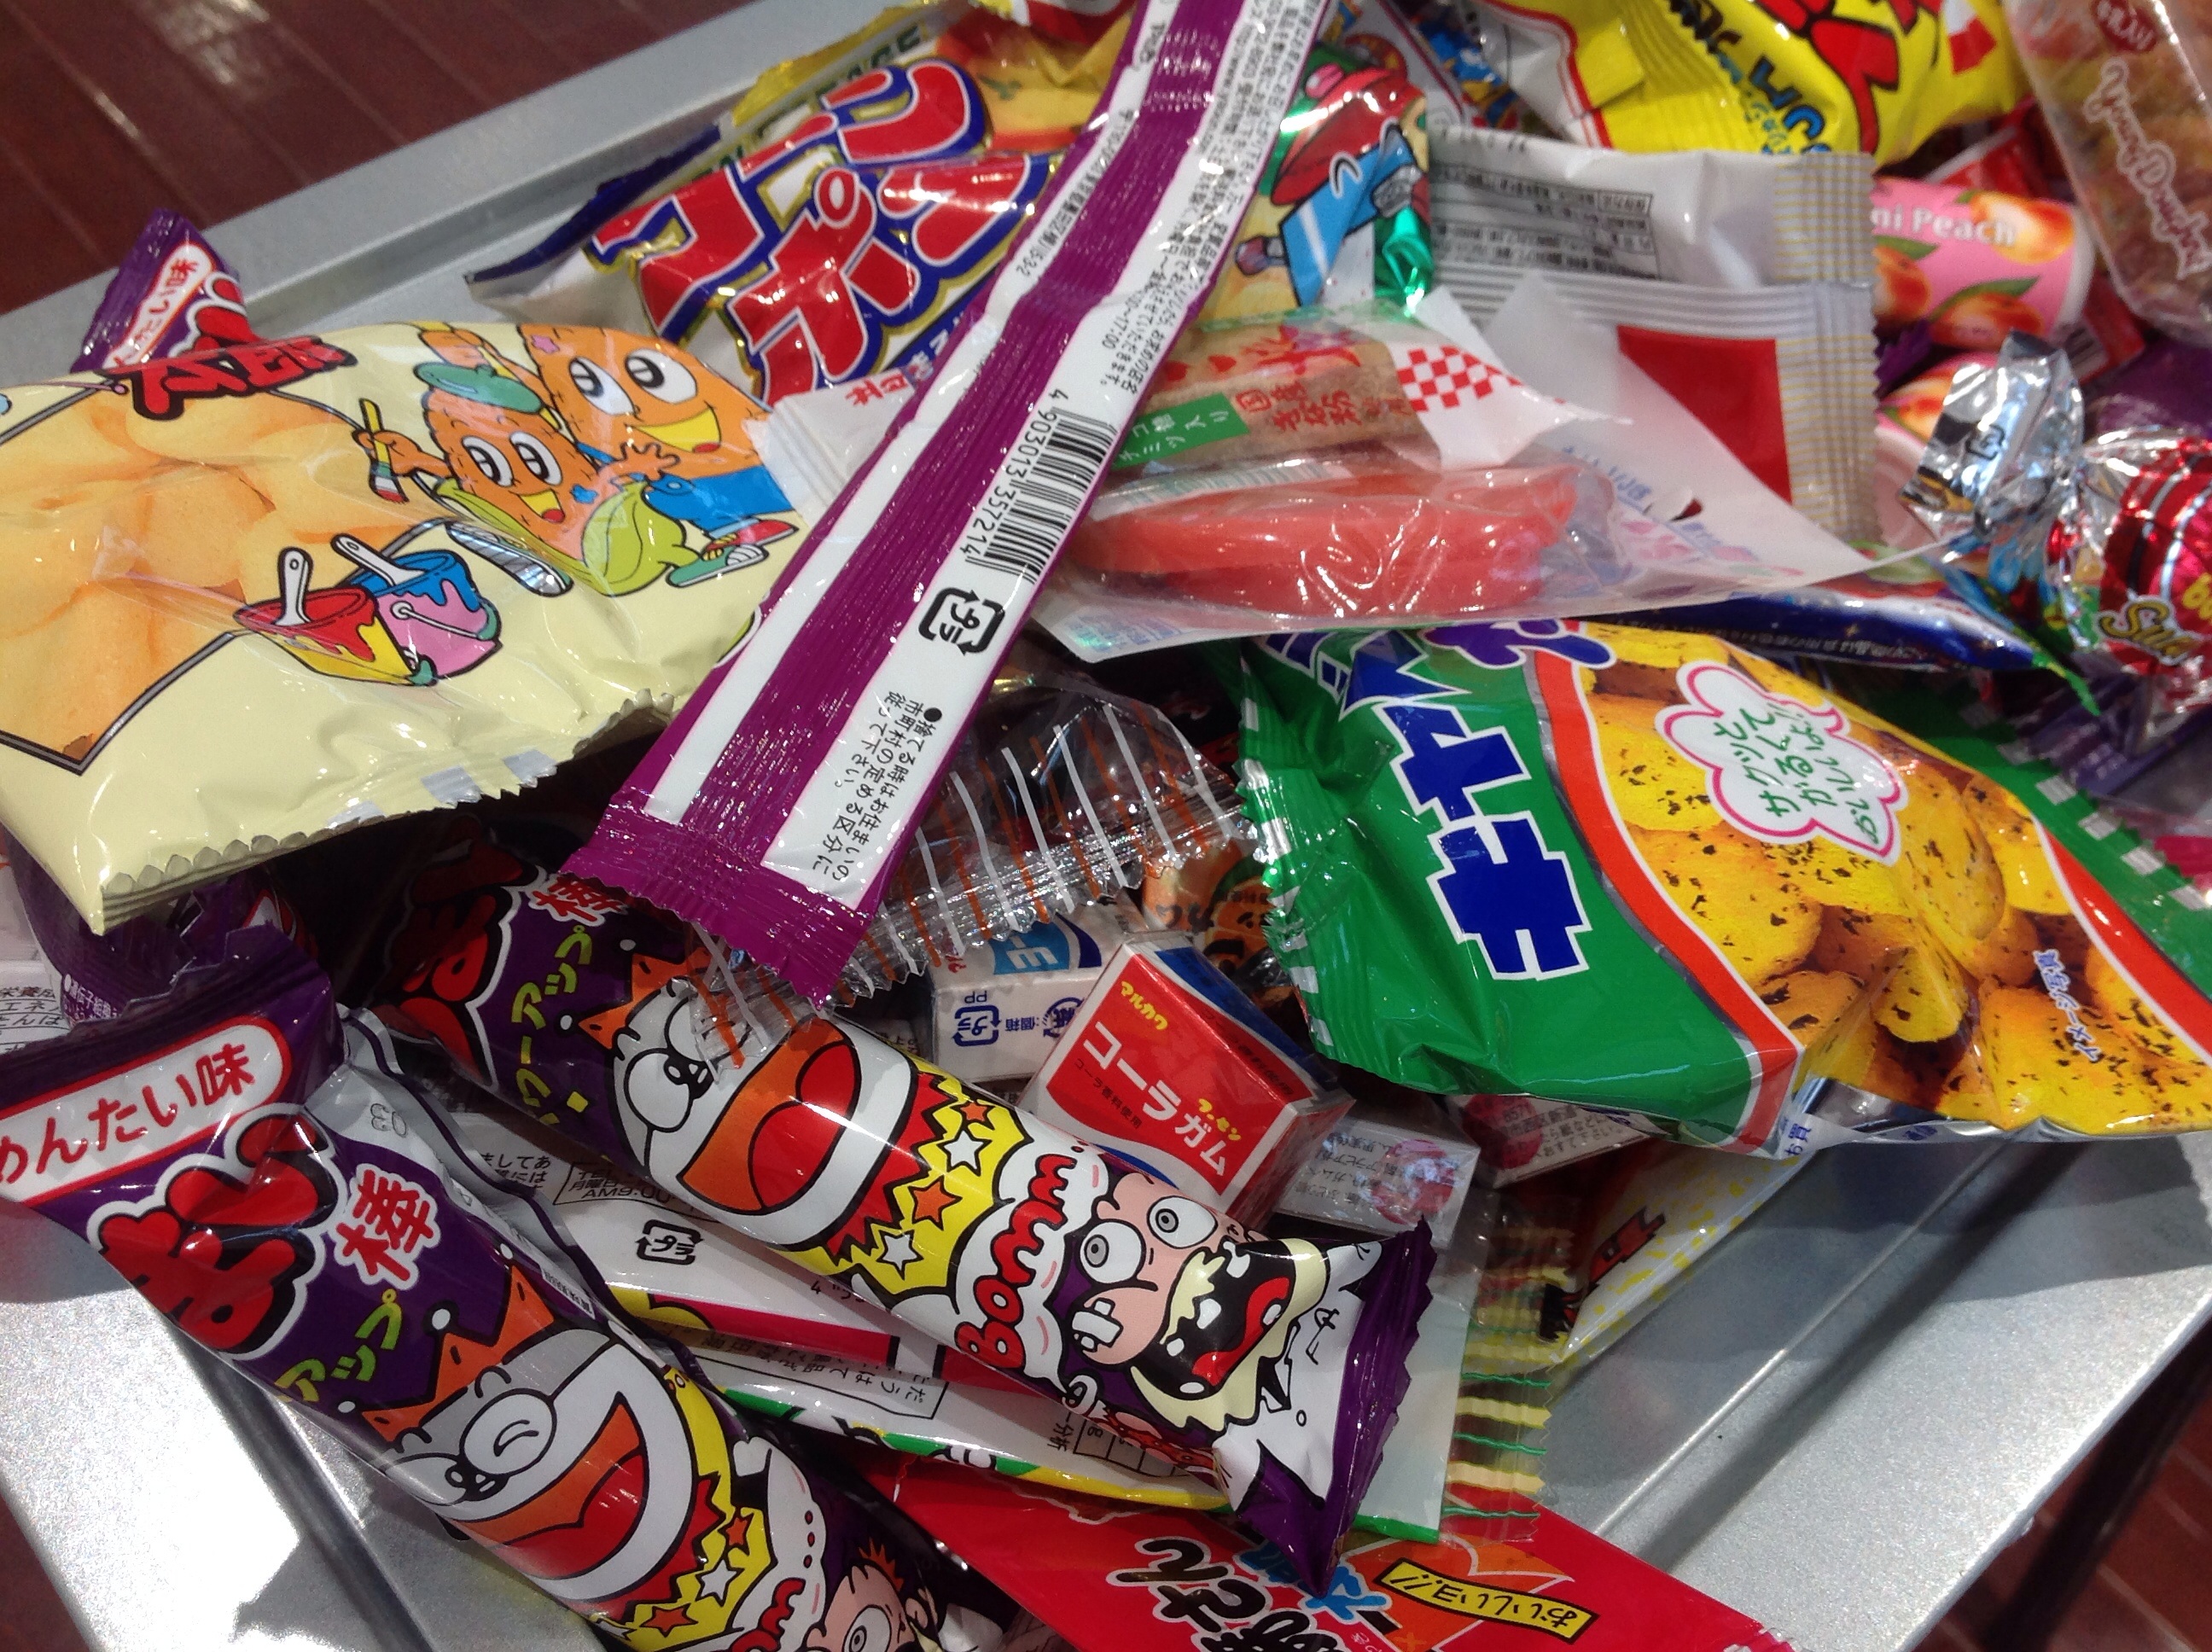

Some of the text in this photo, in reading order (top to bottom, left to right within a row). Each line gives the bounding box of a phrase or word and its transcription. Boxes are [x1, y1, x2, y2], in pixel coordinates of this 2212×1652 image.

[1912, 208, 2017, 247] Peach
[809, 696, 924, 876] 市町村の定める区分に
[515, 924, 593, 1125] ワーアップ
[964, 990, 990, 1004] PP
[1119, 980, 1172, 1032] マルカワ
[1082, 1019, 1229, 1178] コーラガム
[336, 1168, 435, 1281] 棒
[273, 1288, 403, 1402] アップ
[1391, 1572, 1579, 1630] おいしいヨ!!
